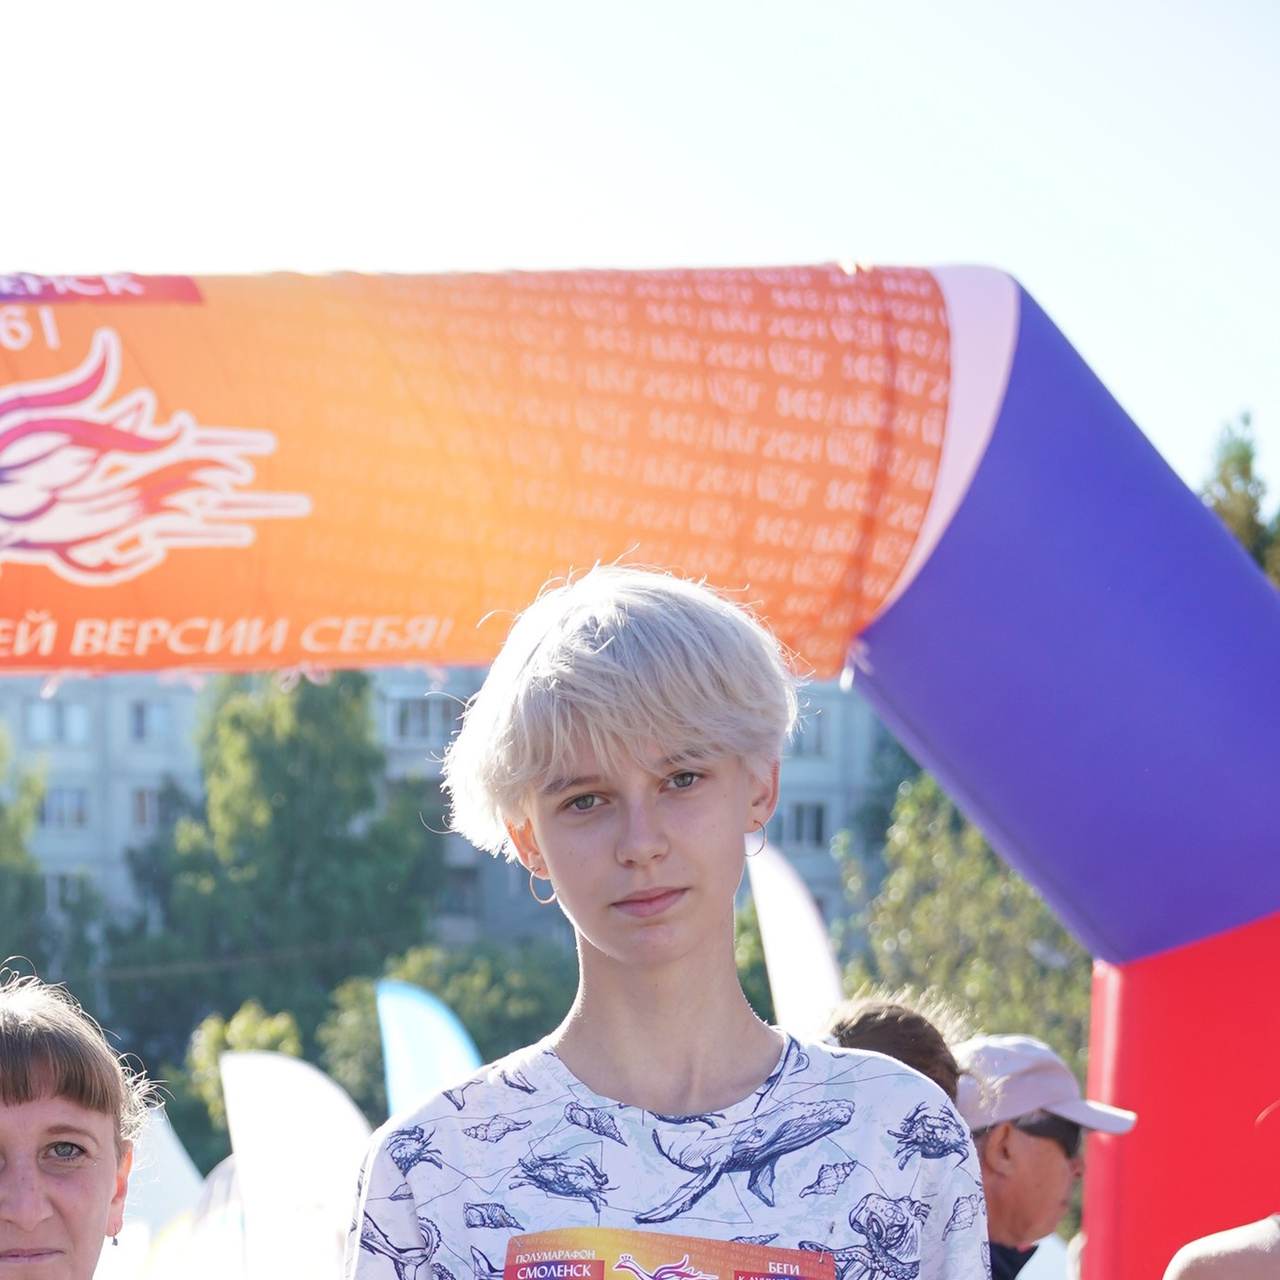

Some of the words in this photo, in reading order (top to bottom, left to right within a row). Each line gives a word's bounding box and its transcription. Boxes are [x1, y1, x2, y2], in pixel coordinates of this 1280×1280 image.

[69, 616, 290, 657] ВЕРСИИ
[300, 615, 454, 654] СЕБЯ!
[515, 1249, 595, 1264] ПОЛУМАРАФОН
[517, 1264, 591, 1280] СМОЛЕНСК
[768, 1261, 800, 1276] БЕГИ
